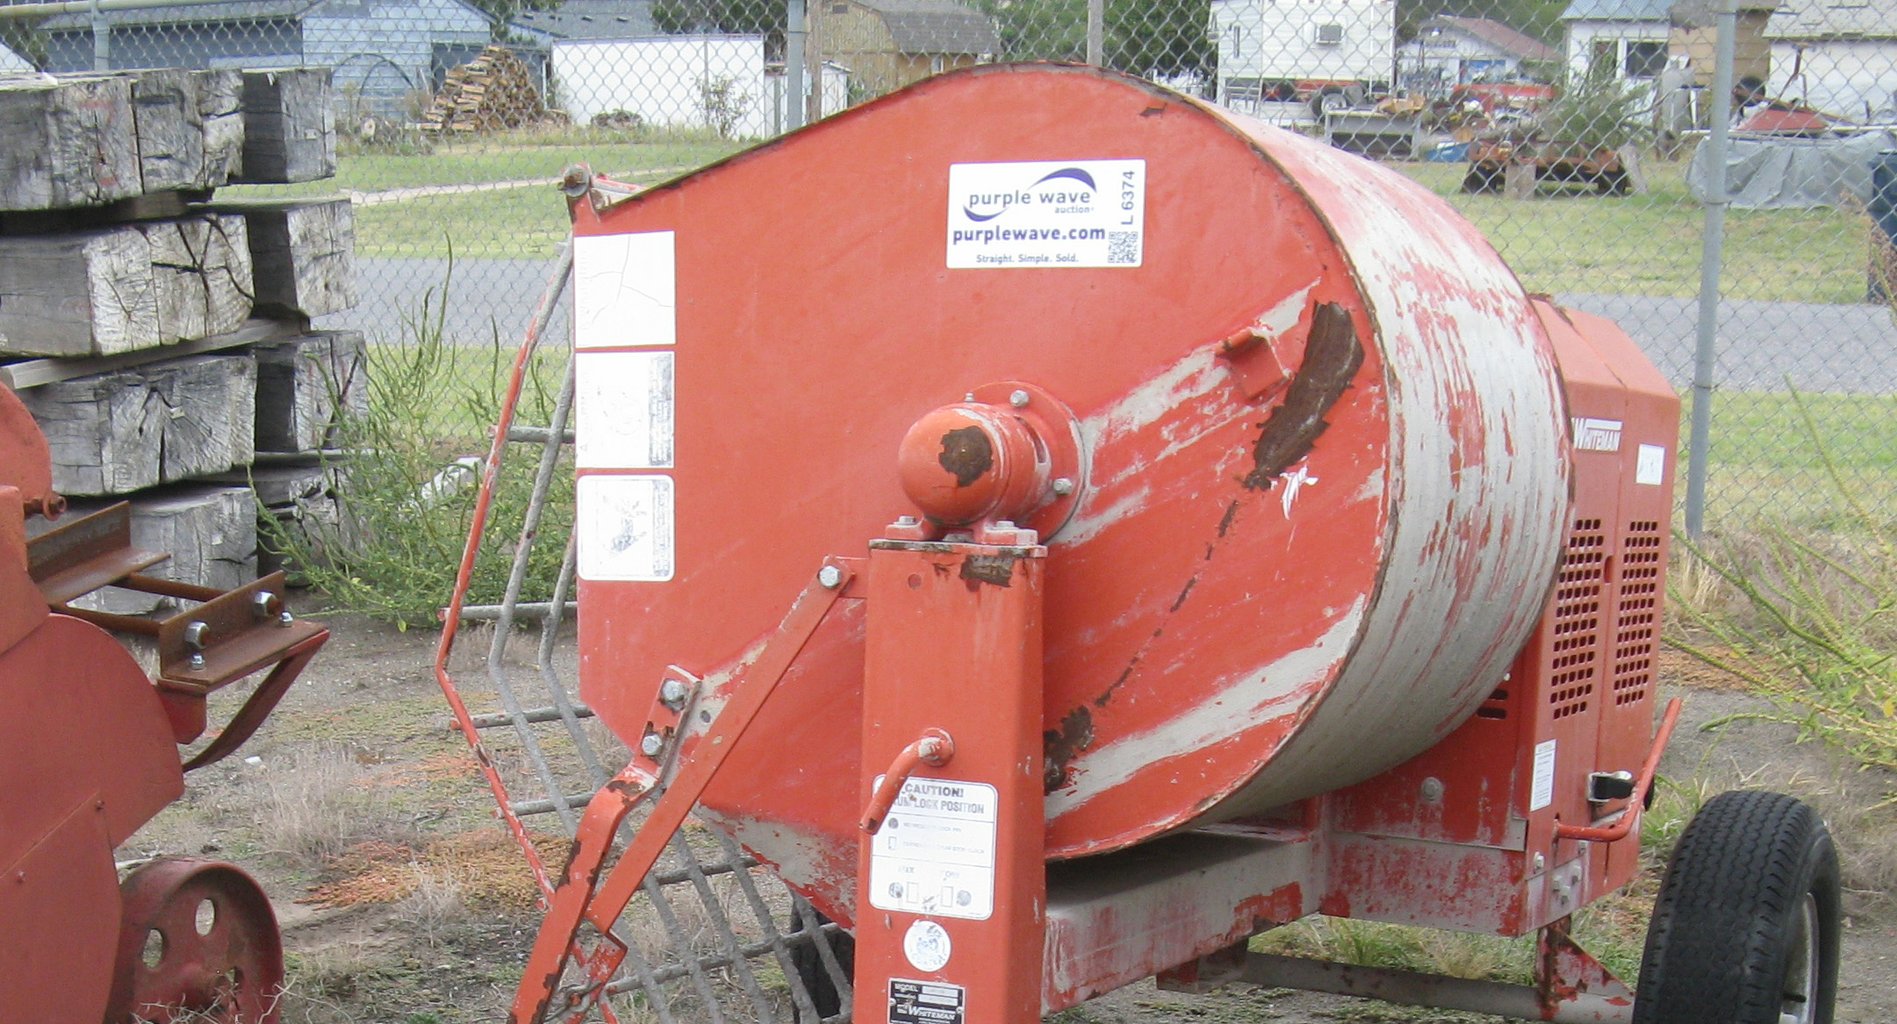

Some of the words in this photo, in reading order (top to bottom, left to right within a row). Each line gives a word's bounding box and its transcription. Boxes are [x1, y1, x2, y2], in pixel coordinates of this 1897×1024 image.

[1121, 170, 1135, 211] 6374
[969, 190, 1031, 208] purple
[1039, 191, 1091, 204] wave
[1054, 205, 1090, 214] auction
[1120, 214, 1134, 225] L
[952, 225, 1106, 245] purplewave.com
[976, 253, 1014, 264] Straight.
[1018, 253, 1052, 264] Simple.
[1056, 253, 1079, 263] Sold.
[904, 783, 964, 797] CAUTION!
